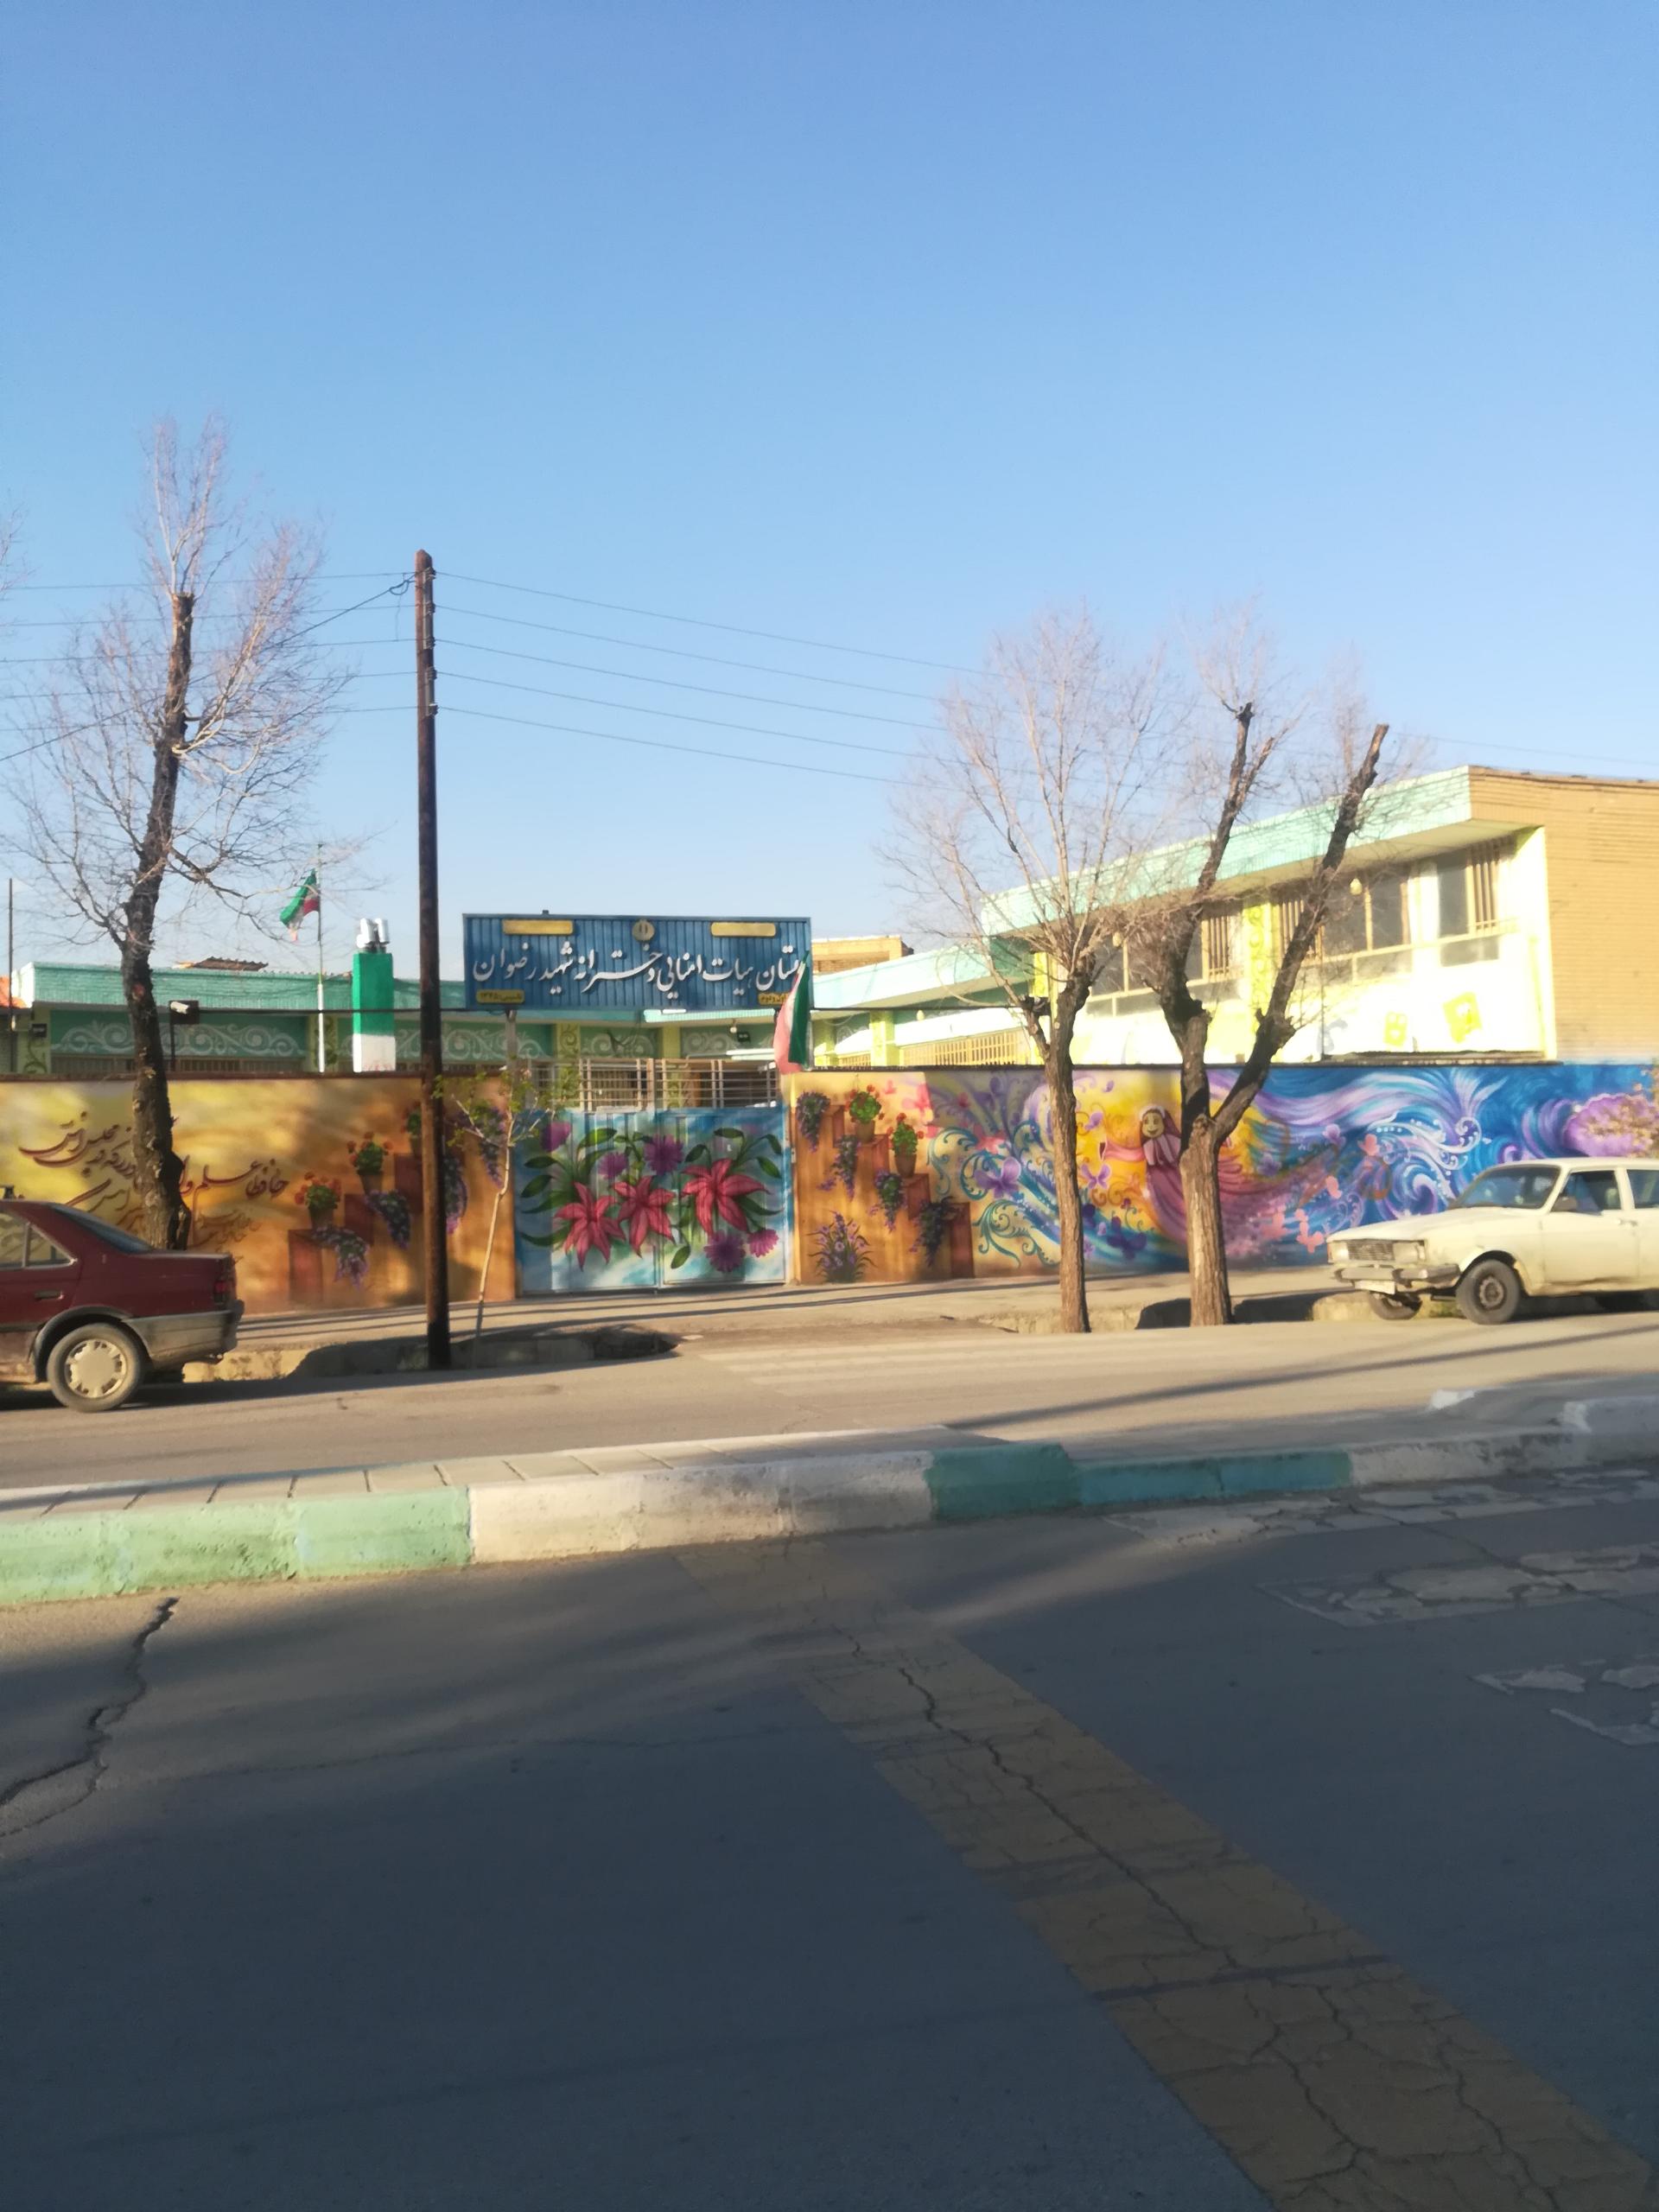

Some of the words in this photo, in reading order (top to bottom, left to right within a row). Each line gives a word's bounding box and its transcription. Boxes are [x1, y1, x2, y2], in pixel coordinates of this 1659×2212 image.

[473, 942, 537, 982] رضوان
[539, 940, 574, 995] شهید
[574, 944, 664, 994] دخترانه
